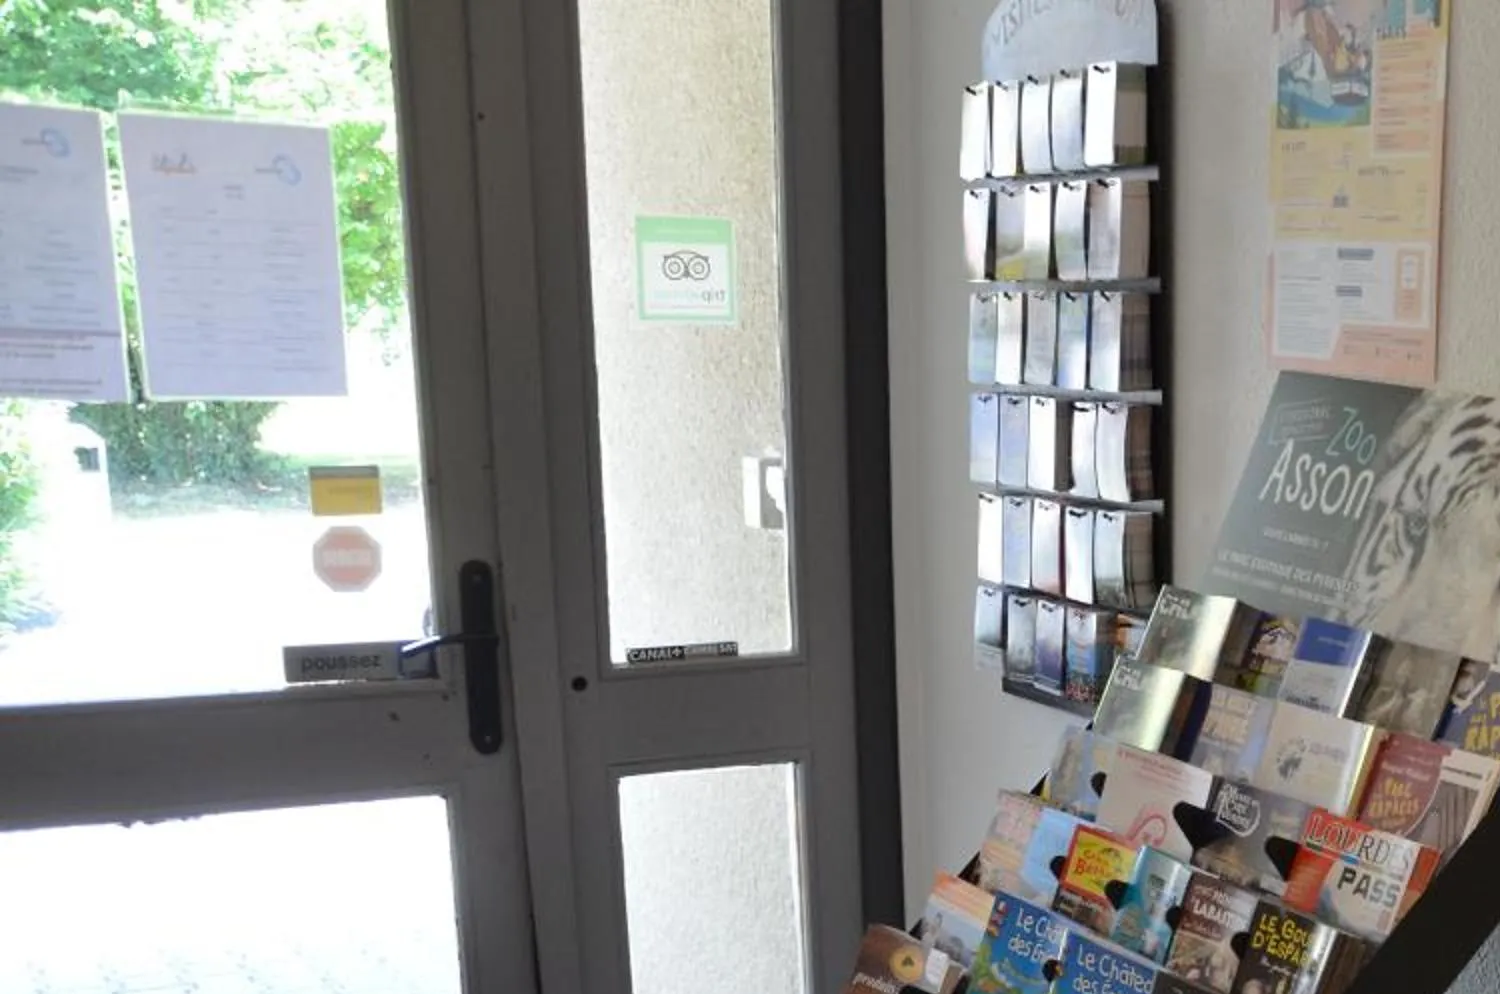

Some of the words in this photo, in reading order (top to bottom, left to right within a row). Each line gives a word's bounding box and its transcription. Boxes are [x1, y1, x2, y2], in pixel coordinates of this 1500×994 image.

[301, 654, 382, 672] poussez
[1337, 866, 1401, 907] PASS
[1260, 913, 1278, 932] LE
[1077, 944, 1095, 971] Le
